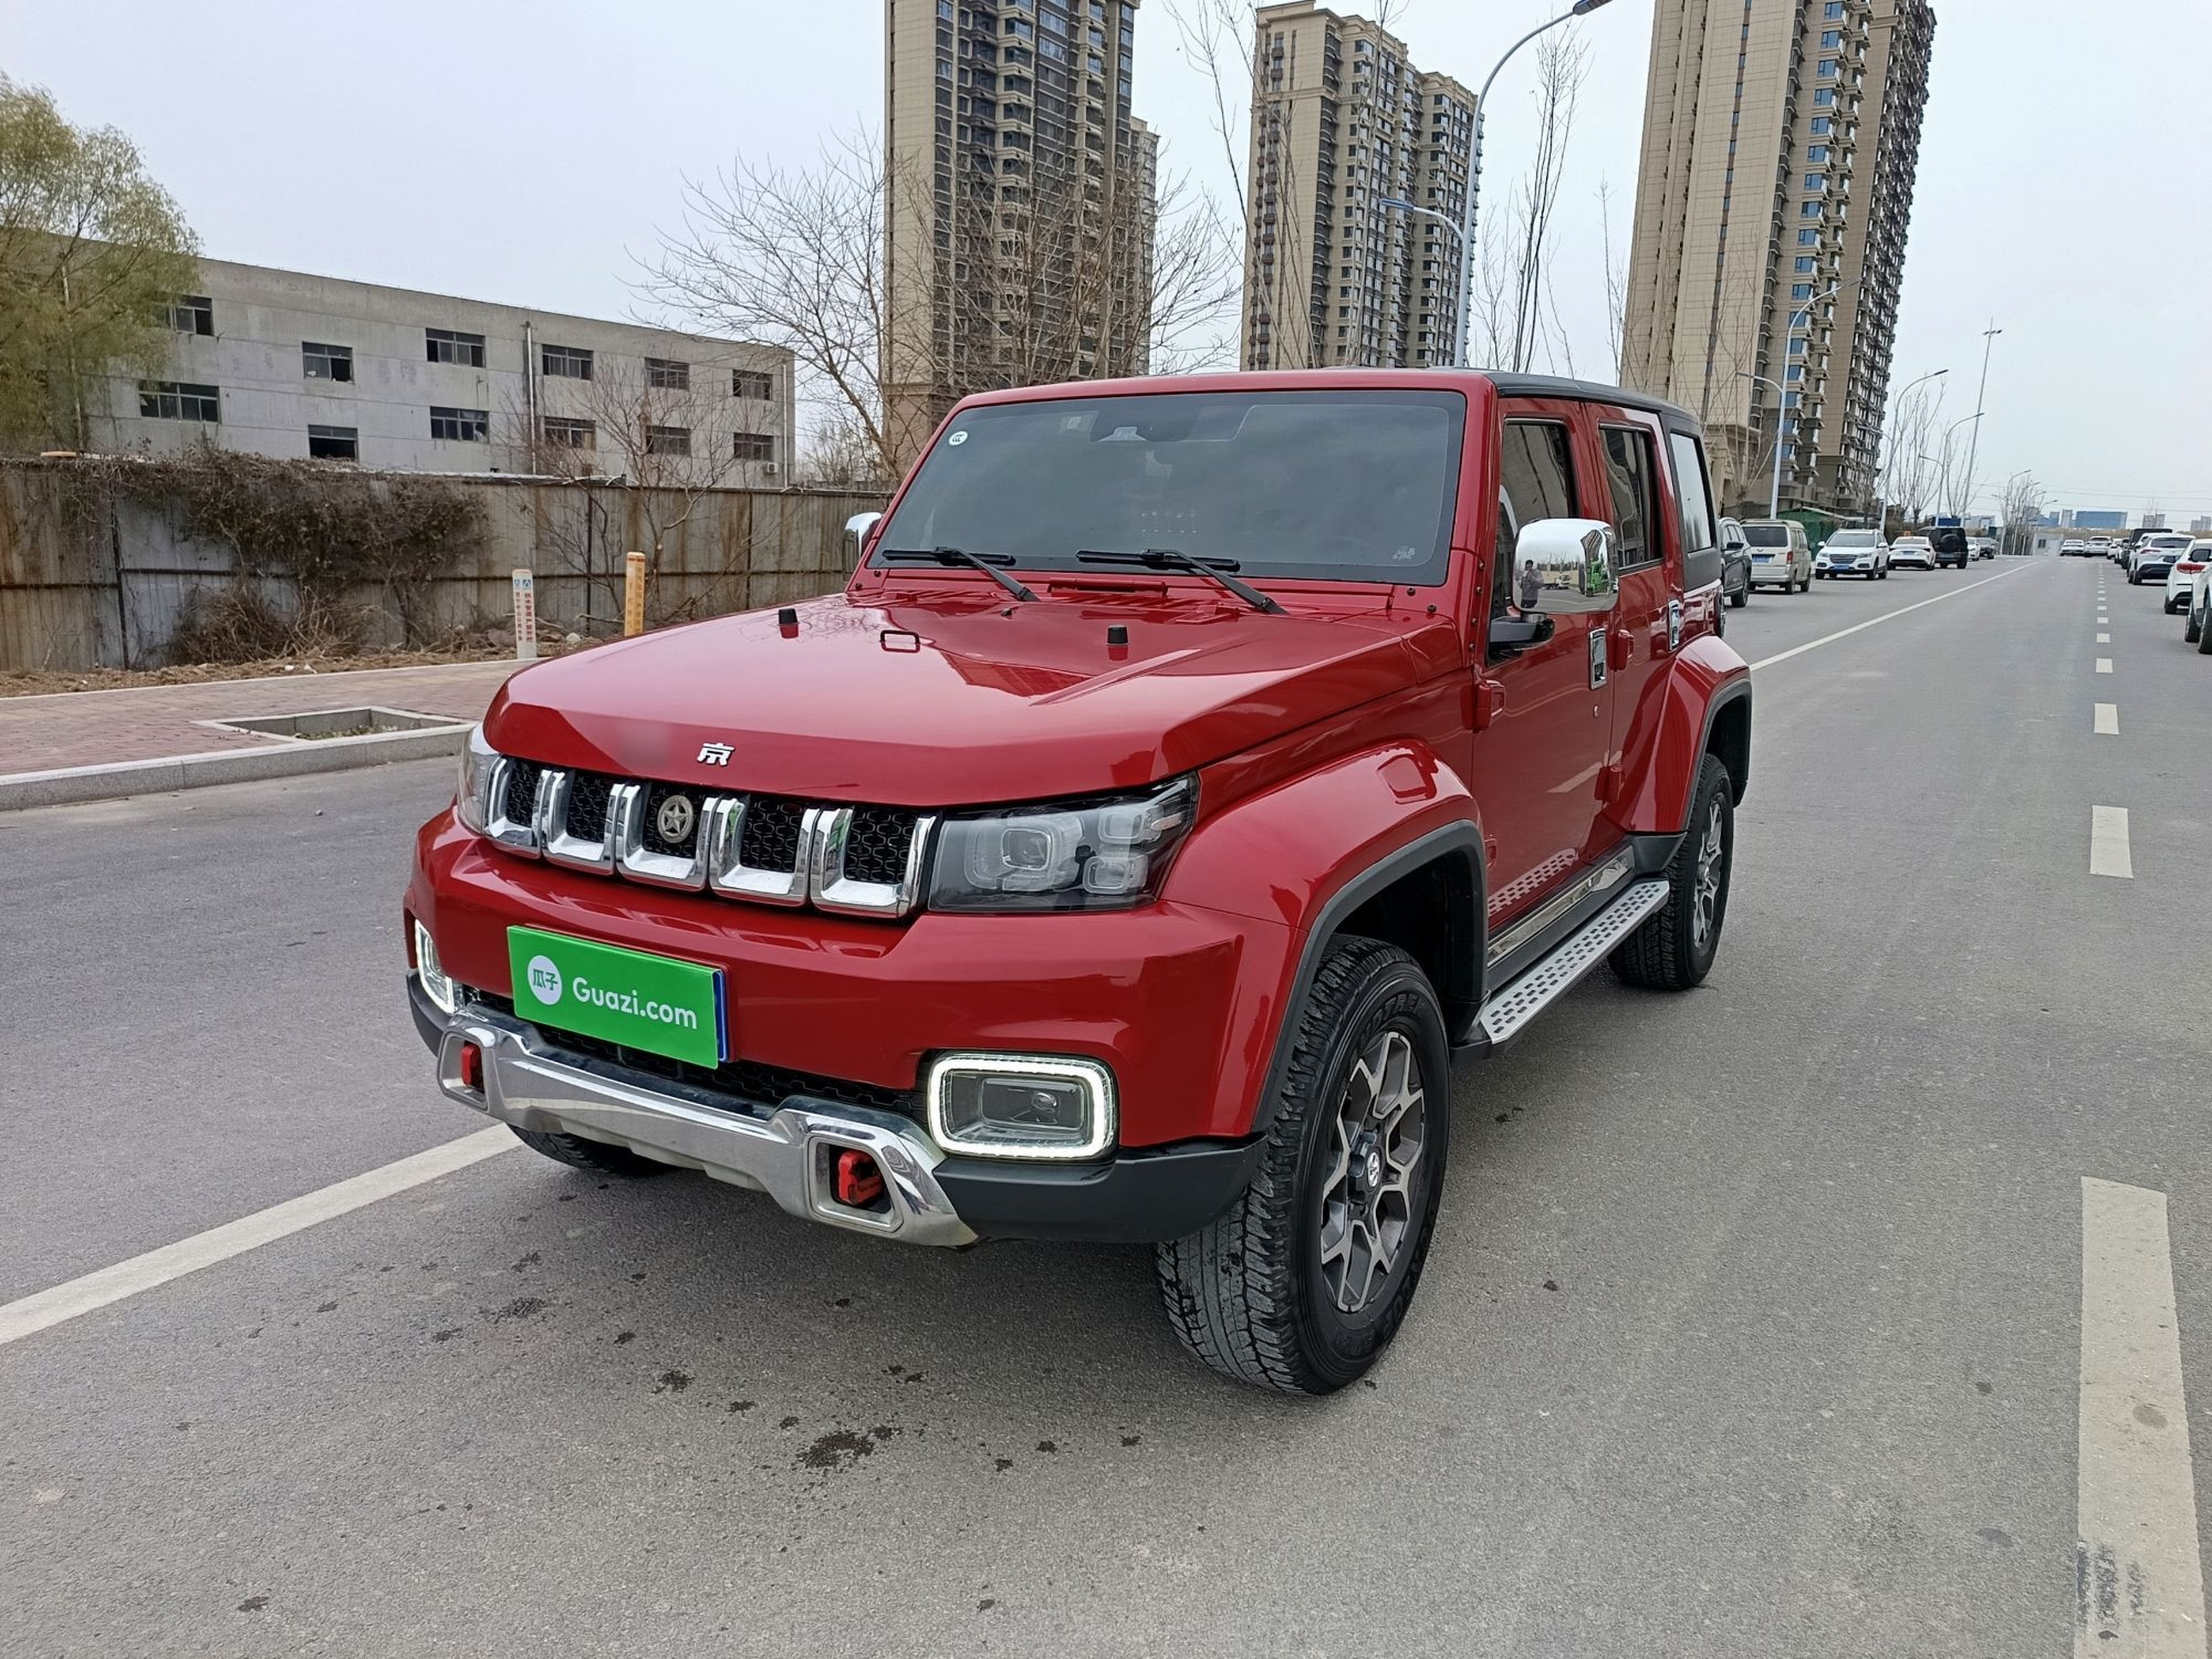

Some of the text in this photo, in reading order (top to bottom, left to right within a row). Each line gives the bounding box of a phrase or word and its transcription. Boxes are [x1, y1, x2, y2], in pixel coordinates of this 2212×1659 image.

[697, 743, 735, 766] 京
[532, 968, 558, 991] 瓜子
[573, 977, 698, 1029] Guazi.com
